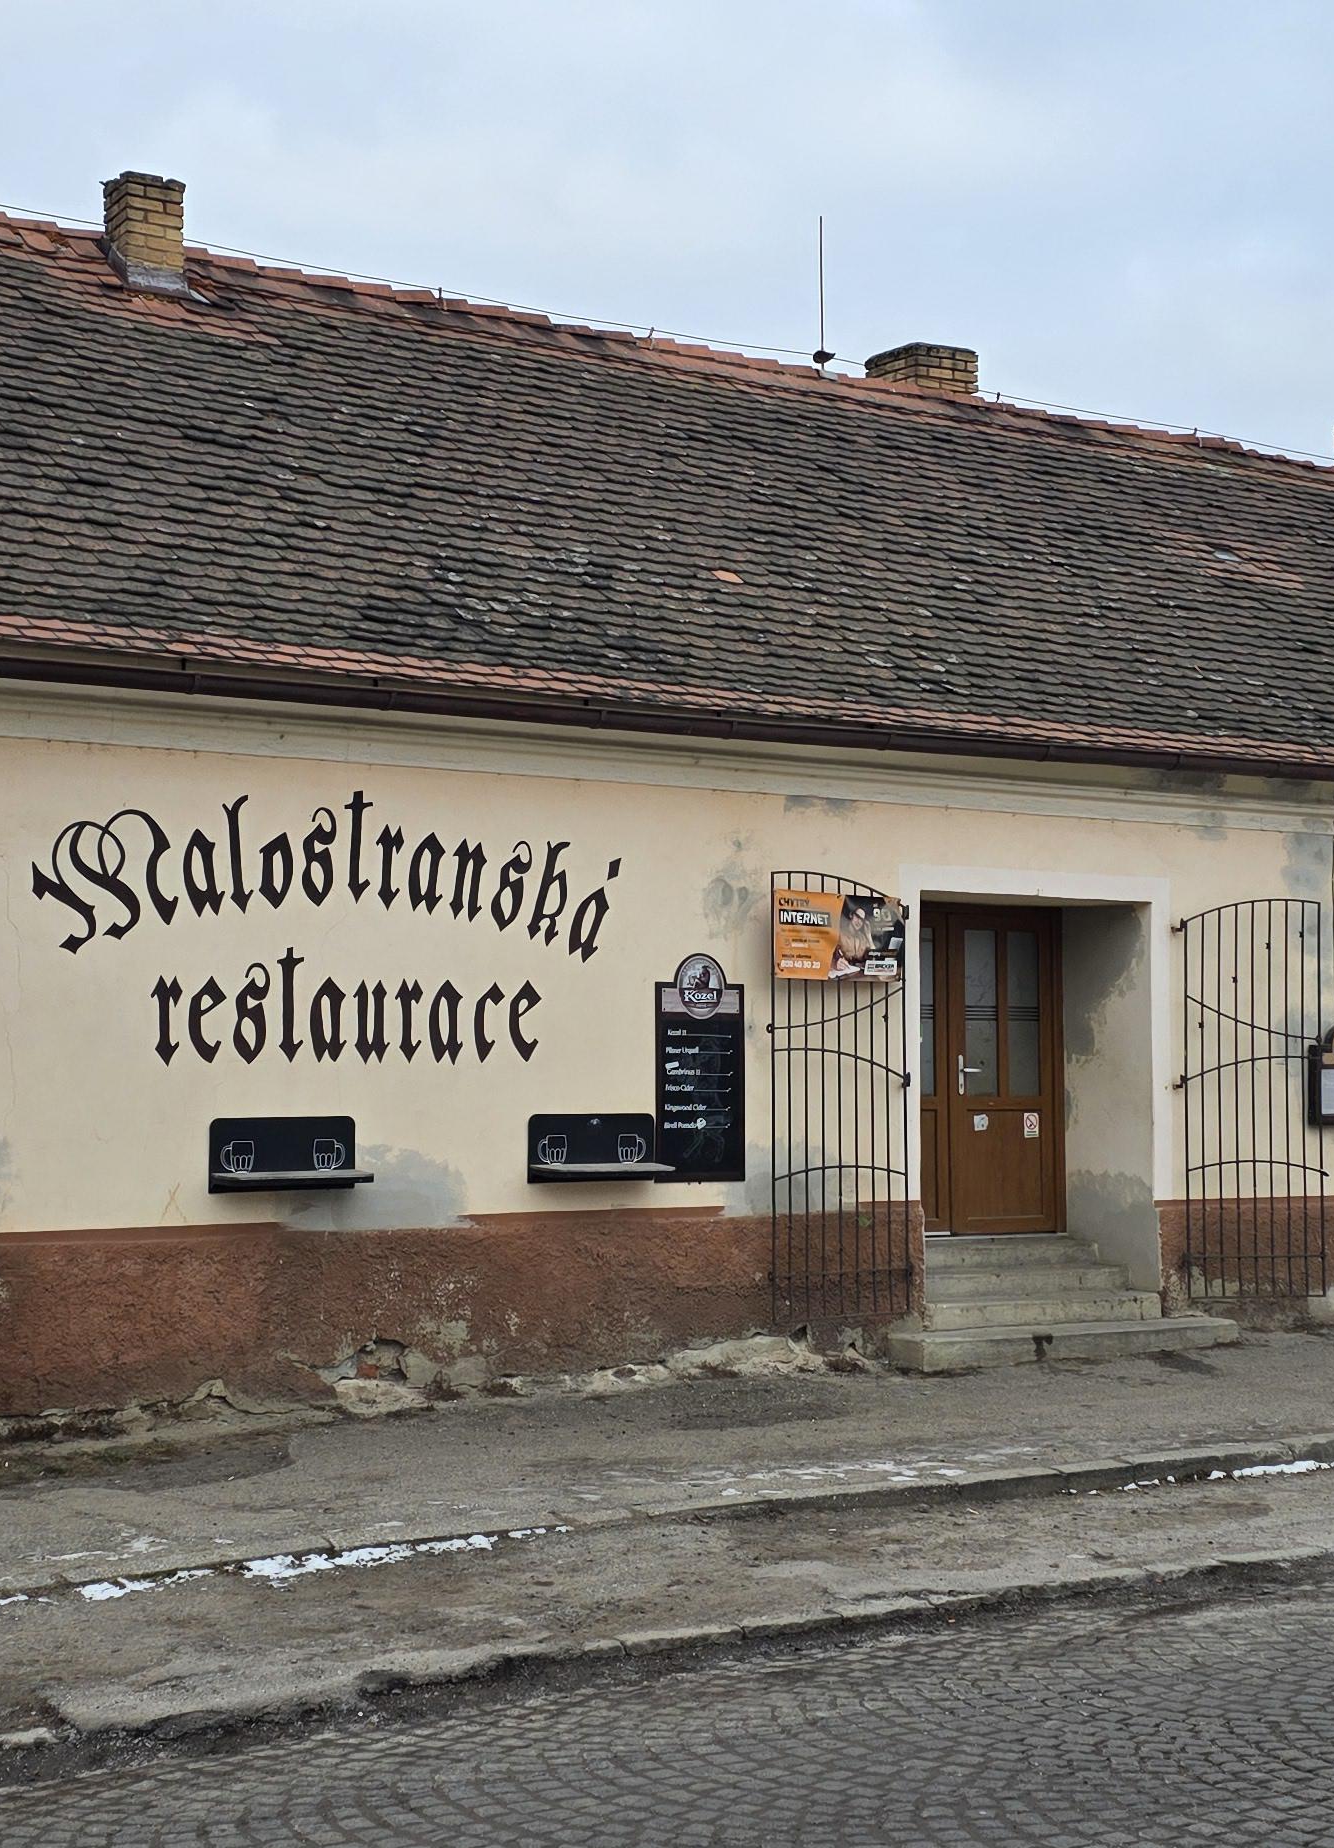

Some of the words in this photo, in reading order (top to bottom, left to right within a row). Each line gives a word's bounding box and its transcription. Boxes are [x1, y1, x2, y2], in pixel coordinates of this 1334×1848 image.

[32, 790, 622, 964] Malostranská
[780, 910, 829, 925] INTERNET
[684, 990, 718, 1003] Kozel
[151, 947, 542, 1066] restaurace
[693, 1103, 707, 1111] Cider
